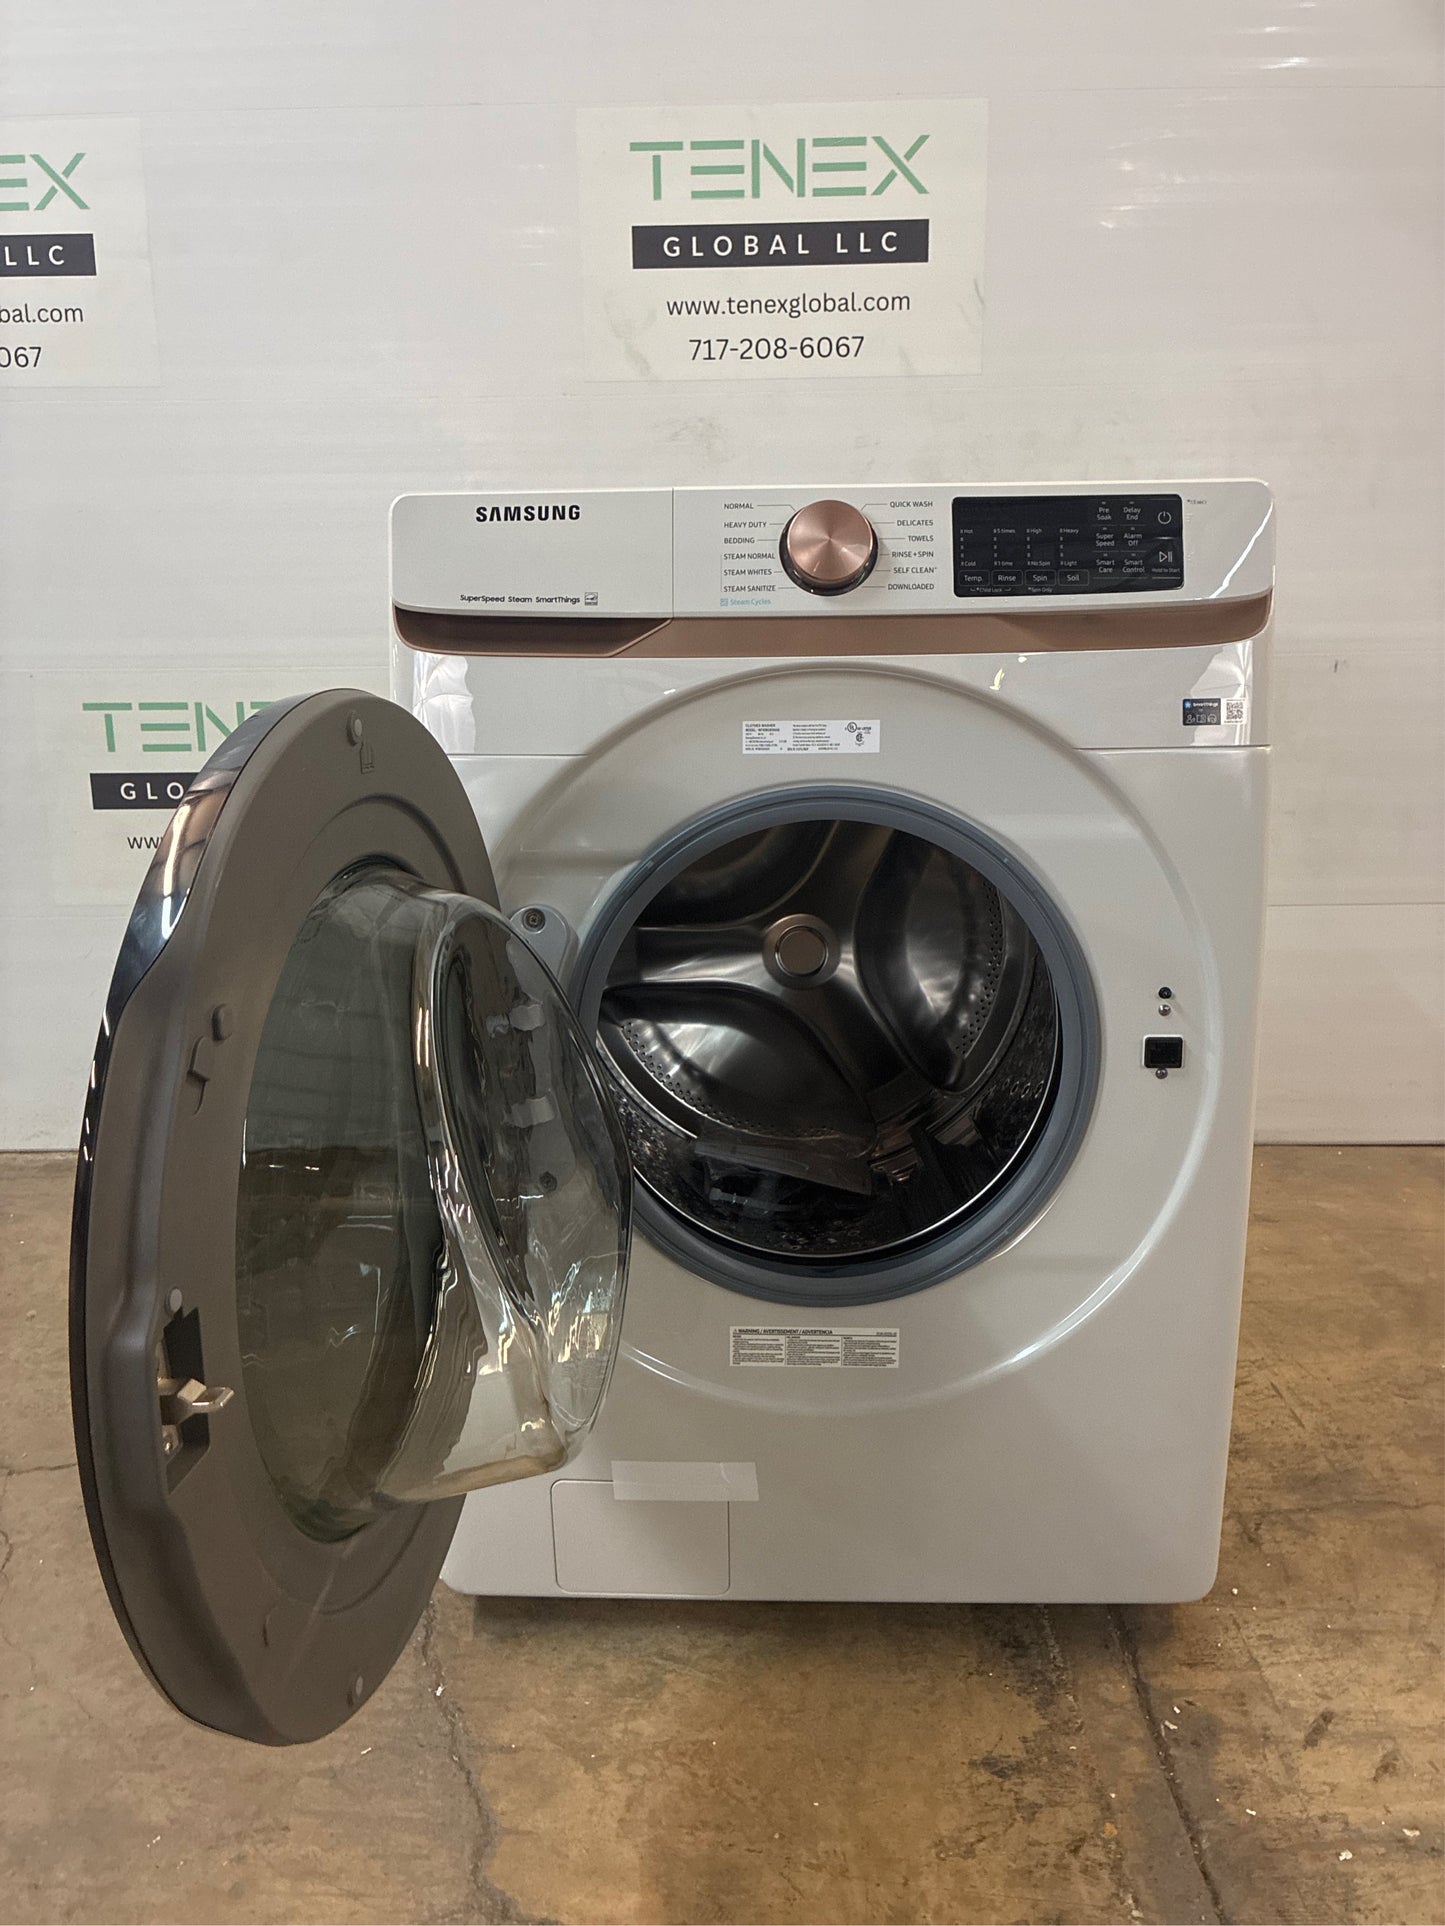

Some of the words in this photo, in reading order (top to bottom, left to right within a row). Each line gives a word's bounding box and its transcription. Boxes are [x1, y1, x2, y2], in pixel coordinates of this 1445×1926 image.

[629, 134, 931, 201] TENEX
[662, 233, 810, 258] GLOBAL
[836, 230, 899, 254] LLC
[4, 245, 66, 266] LLC
[666, 292, 912, 318] www.tenexglobal.com
[688, 336, 865, 361] 717-208-6067
[475, 505, 581, 523] SAMSUNG
[896, 519, 934, 527] DELICATES
[963, 575, 983, 583] Temp
[997, 574, 1017, 582] Rinse
[1032, 574, 1048, 583] Spin
[1066, 574, 1080, 582] Soil
[747, 585, 776, 593] SANITIZE
[887, 583, 935, 591] DOWNLOADED
[460, 594, 506, 604] SuperSpeed
[535, 596, 581, 605] SmartThings
[82, 701, 274, 753] TEN
